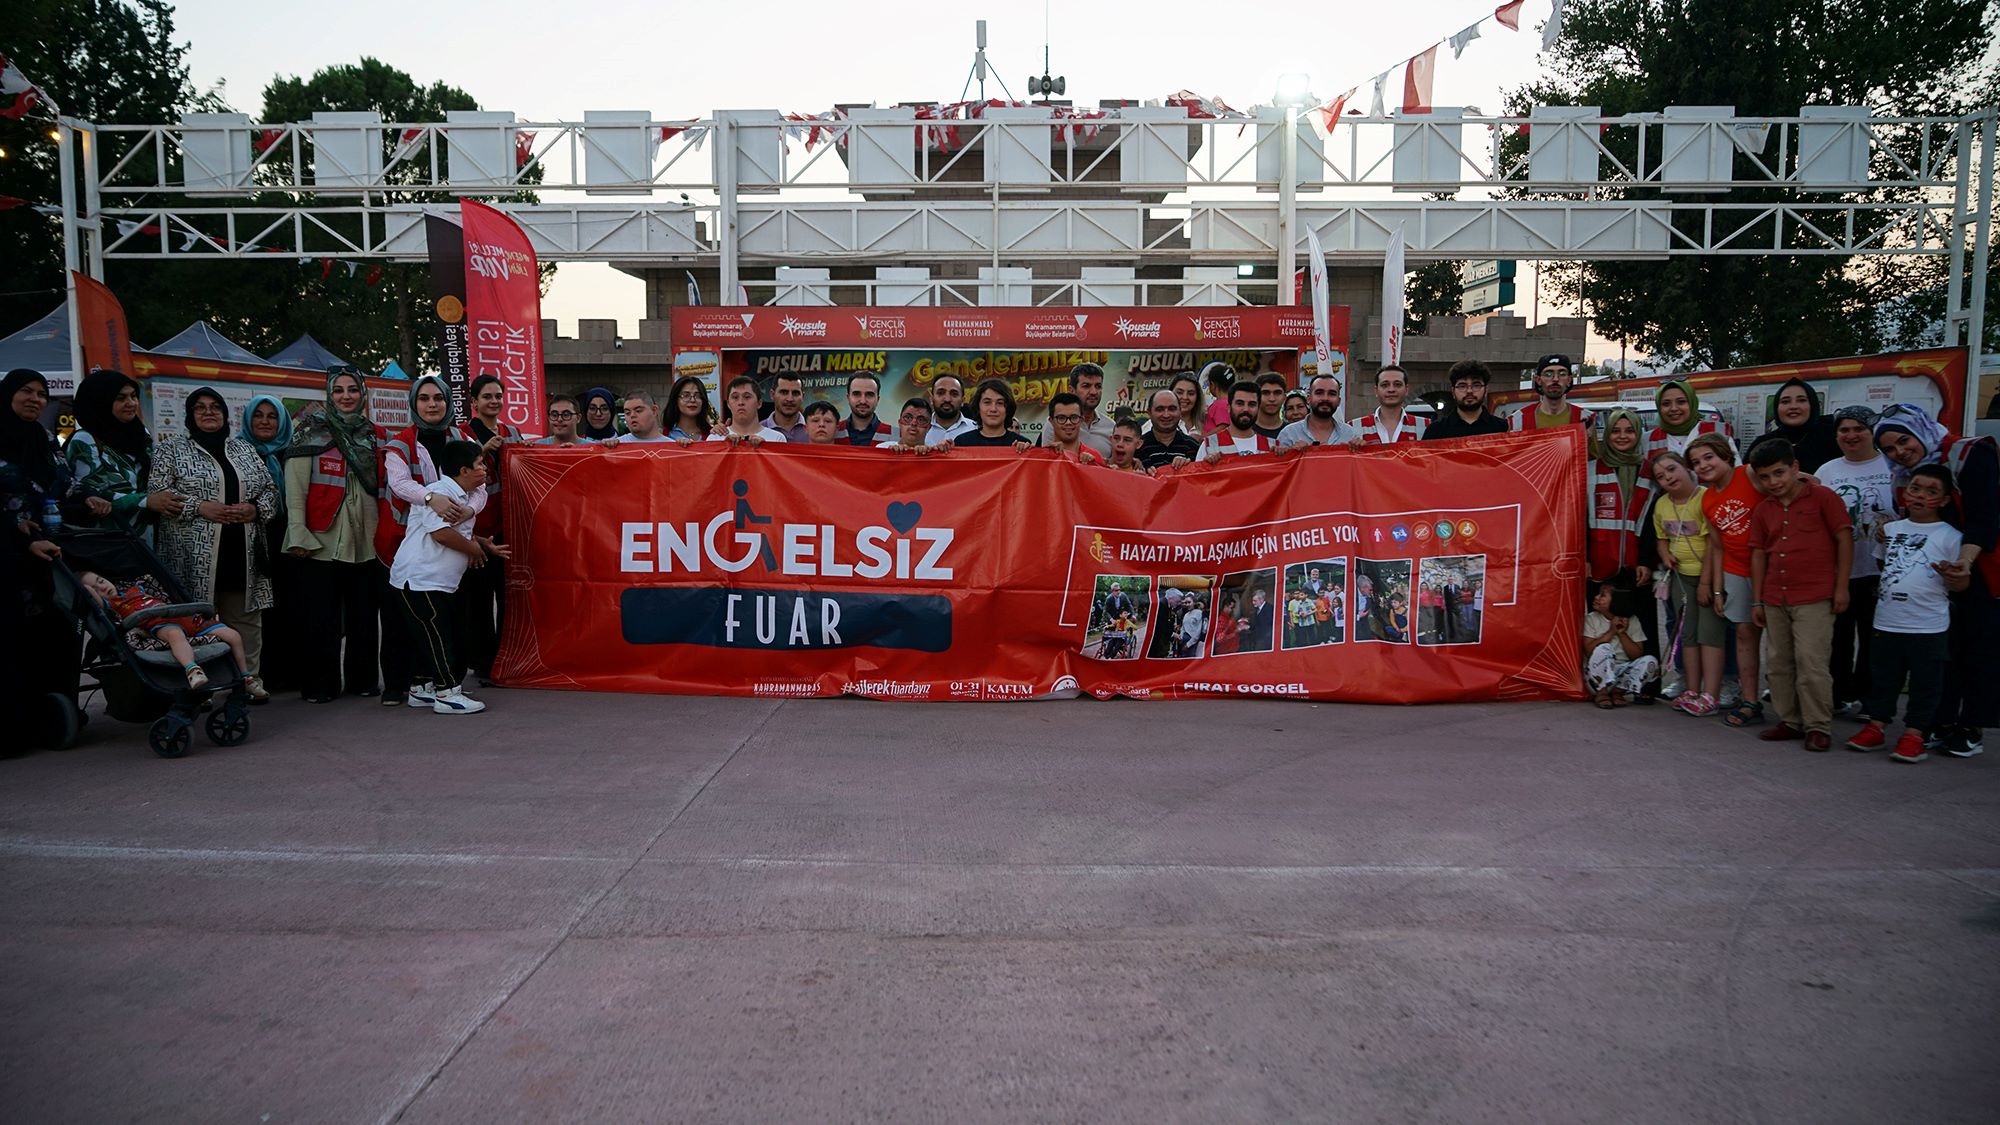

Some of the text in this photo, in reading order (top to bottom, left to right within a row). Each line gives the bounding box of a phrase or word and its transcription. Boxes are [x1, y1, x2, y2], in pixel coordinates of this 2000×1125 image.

[692, 322, 742, 330] Kahramanmaraş
[794, 320, 827, 332] pusula
[869, 319, 906, 330] GENÇLİK
[1025, 323, 1075, 331] Kahramanmaraş
[1128, 321, 1161, 334] pusula
[1203, 319, 1240, 330] GENÇLİK
[797, 328, 827, 337] maraş
[869, 328, 906, 338] MECLİSİ
[1131, 330, 1160, 338] maraş
[1203, 328, 1241, 339] MECLİSİ
[757, 351, 888, 374] PUSULA MARAŞ
[1128, 352, 1194, 373] PUSULA
[1855, 474, 1889, 482] YOURSEL
[1120, 543, 1169, 562] HAYATI
[1174, 539, 1248, 565] PAYLAŞMAK
[1251, 533, 1278, 559] İÇİN
[1283, 527, 1329, 551] ENGEL
[1331, 525, 1360, 545] YOK
[725, 594, 842, 645] FUAR
[987, 684, 1033, 695] KAFUM
